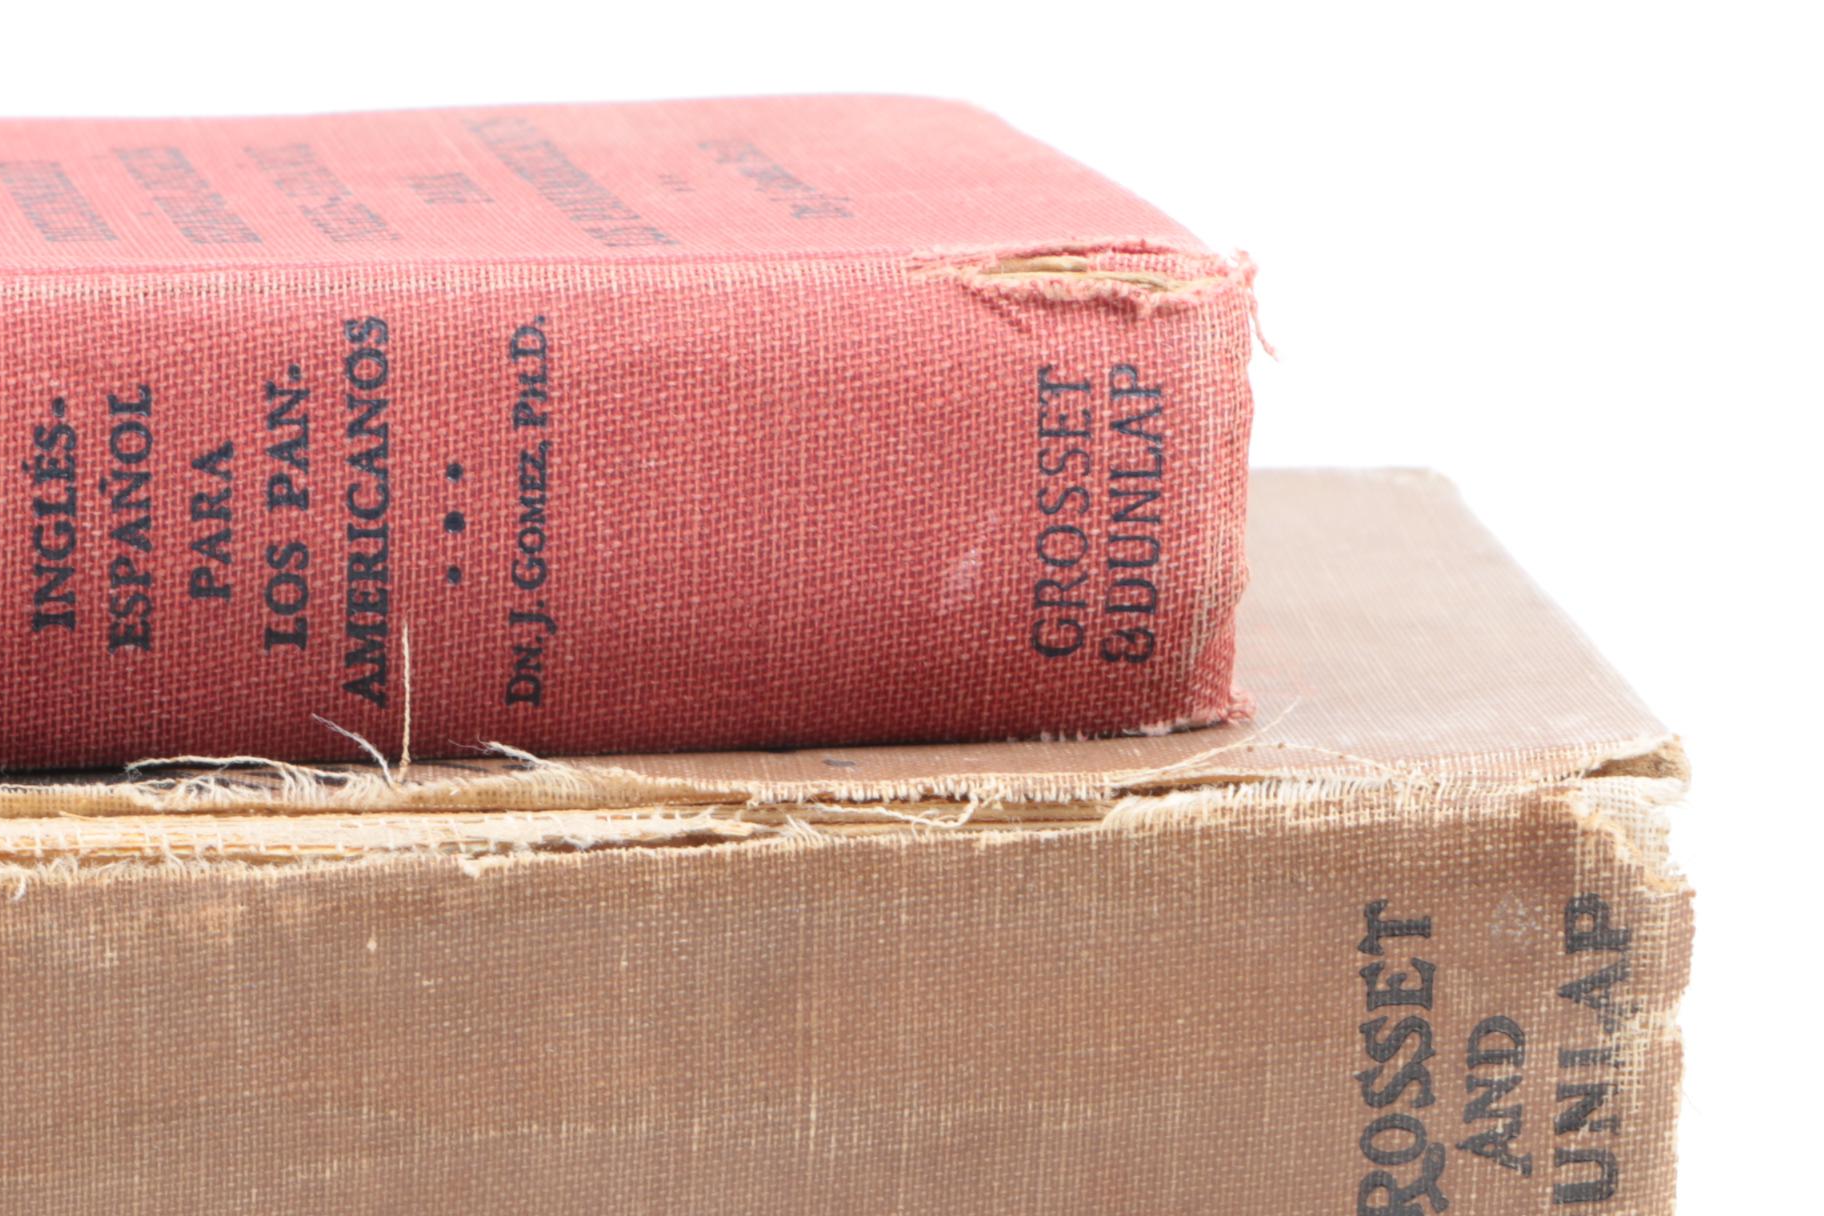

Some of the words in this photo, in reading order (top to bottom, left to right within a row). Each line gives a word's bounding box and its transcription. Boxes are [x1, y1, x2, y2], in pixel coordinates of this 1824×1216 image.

[20, 397, 78, 633] INGLÉS-
[97, 385, 153, 652] ESPAÑOL
[190, 441, 232, 602] PARA
[266, 364, 310, 510] PAN-
[345, 315, 390, 709] AMERICANOS
[1030, 364, 1092, 659] GROSSET
[265, 541, 310, 650] LOS
[1455, 1014, 1533, 1177] AND
